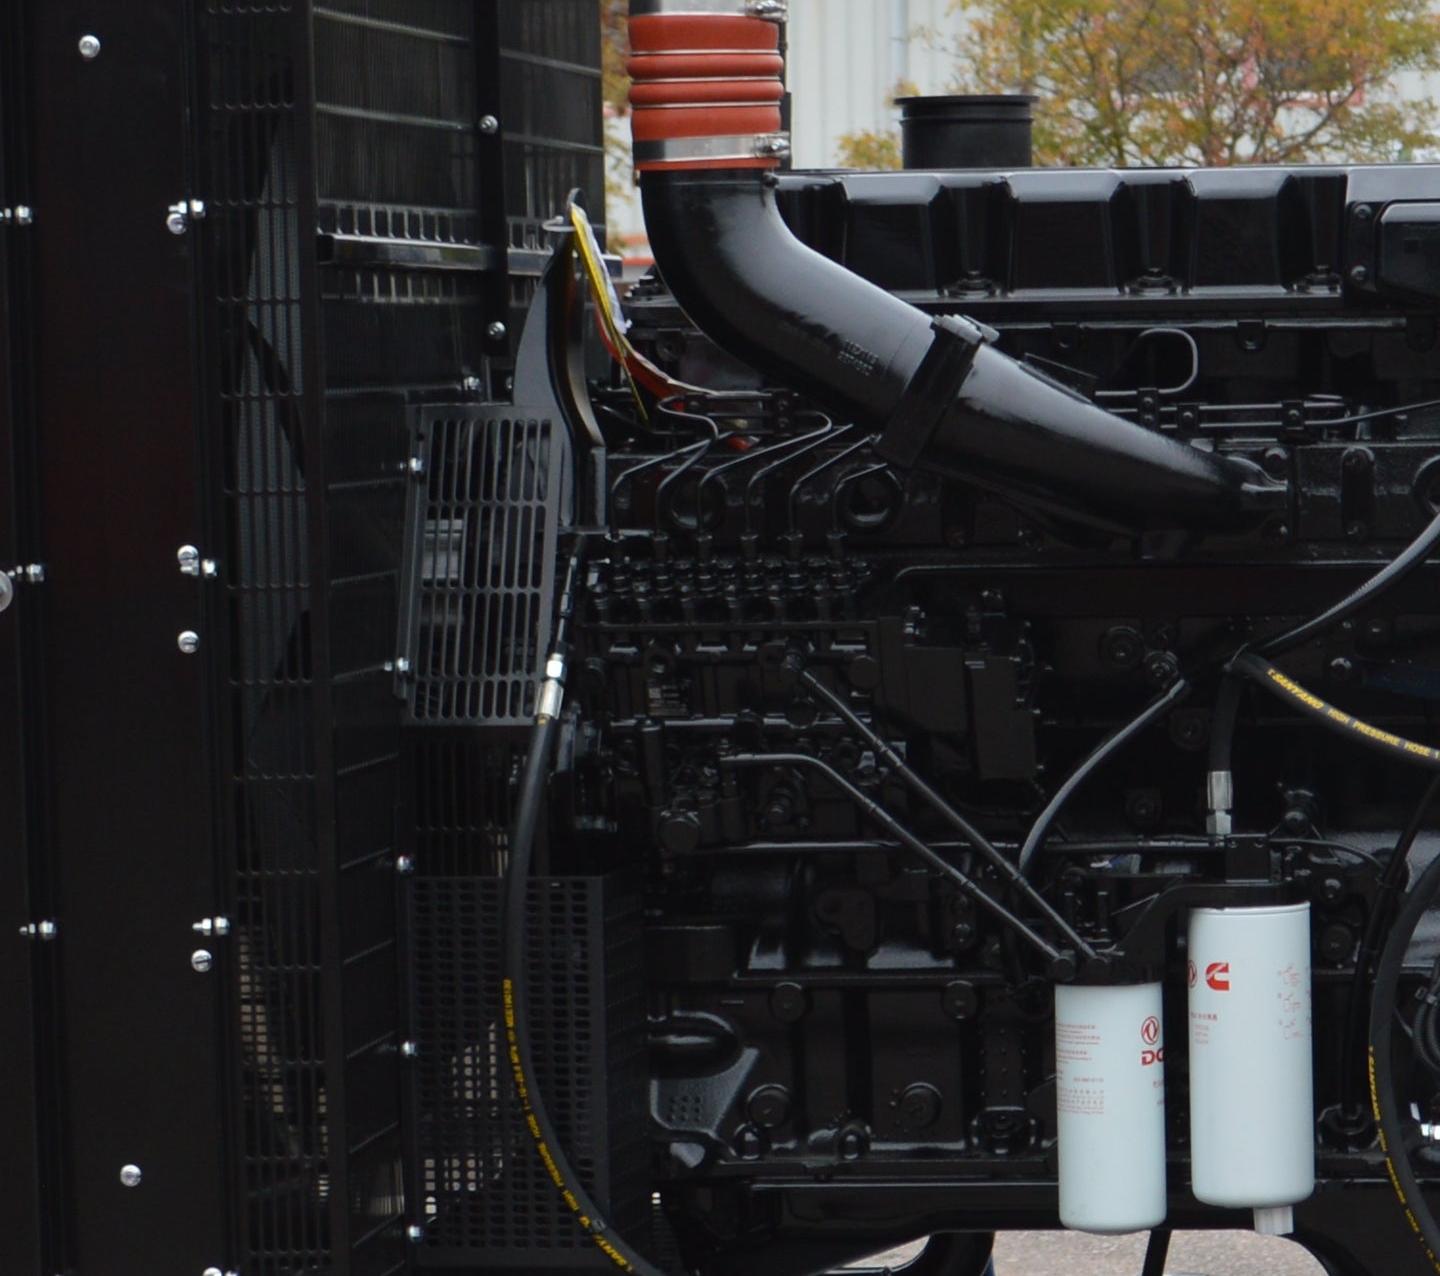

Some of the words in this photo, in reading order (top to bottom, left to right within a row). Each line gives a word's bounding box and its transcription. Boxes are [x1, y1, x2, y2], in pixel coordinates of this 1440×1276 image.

[1326, 707, 1351, 725] HIGH
[1352, 720, 1401, 747] PRESSURE
[1404, 740, 1431, 758] HOSE
